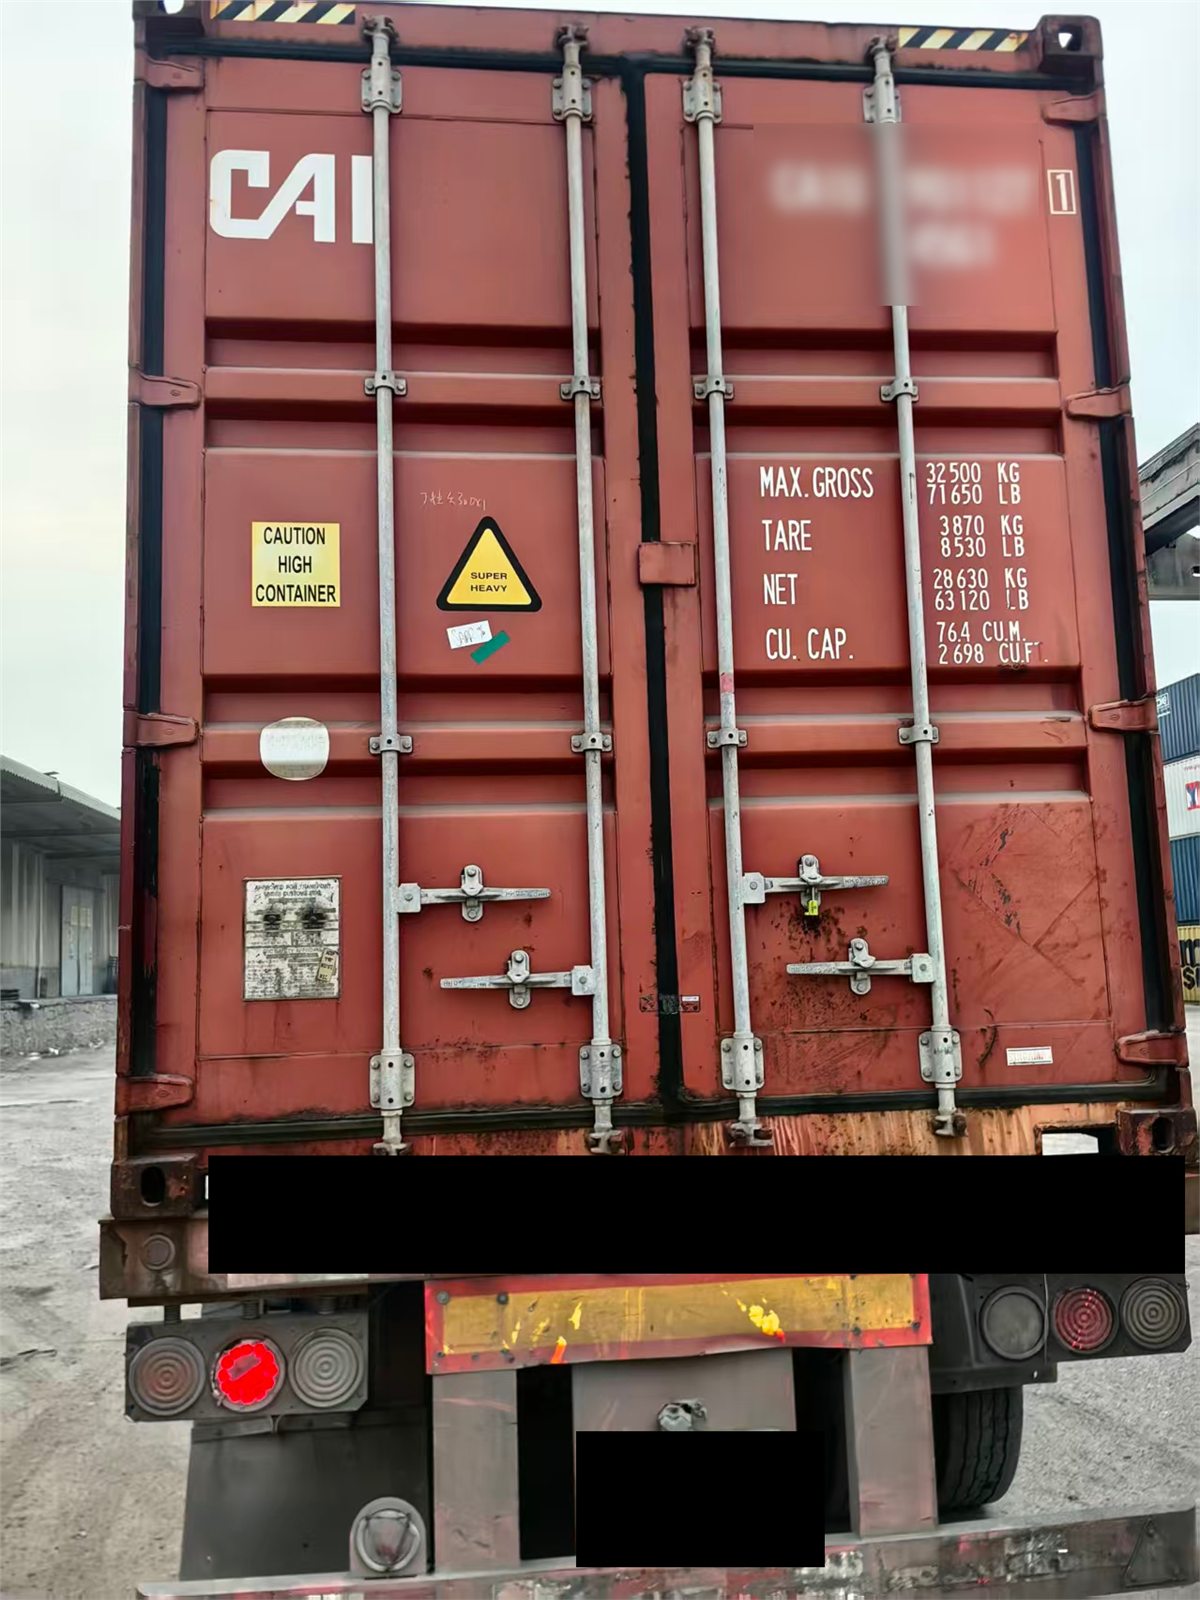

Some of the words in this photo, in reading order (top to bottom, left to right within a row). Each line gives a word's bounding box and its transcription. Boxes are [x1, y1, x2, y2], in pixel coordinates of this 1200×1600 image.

[210, 150, 373, 244] CAI
[1056, 173, 1068, 210] 1
[997, 462, 1020, 483] KG
[999, 484, 1021, 505] LB
[263, 526, 326, 545] CAUTION
[762, 519, 812, 551] TARE
[1001, 515, 1024, 535] KG
[1002, 537, 1025, 557] LB
[278, 555, 312, 574] HIGH
[470, 572, 508, 580] SUPER
[255, 584, 336, 603] CONTAINER
[470, 584, 508, 592] HEAVY
[763, 573, 798, 605] NET
[1004, 568, 1028, 588] KG
[1006, 590, 1029, 610] LB
[765, 628, 798, 660] CU.
[807, 628, 854, 660] CAP.
[936, 621, 971, 642] 76.4
